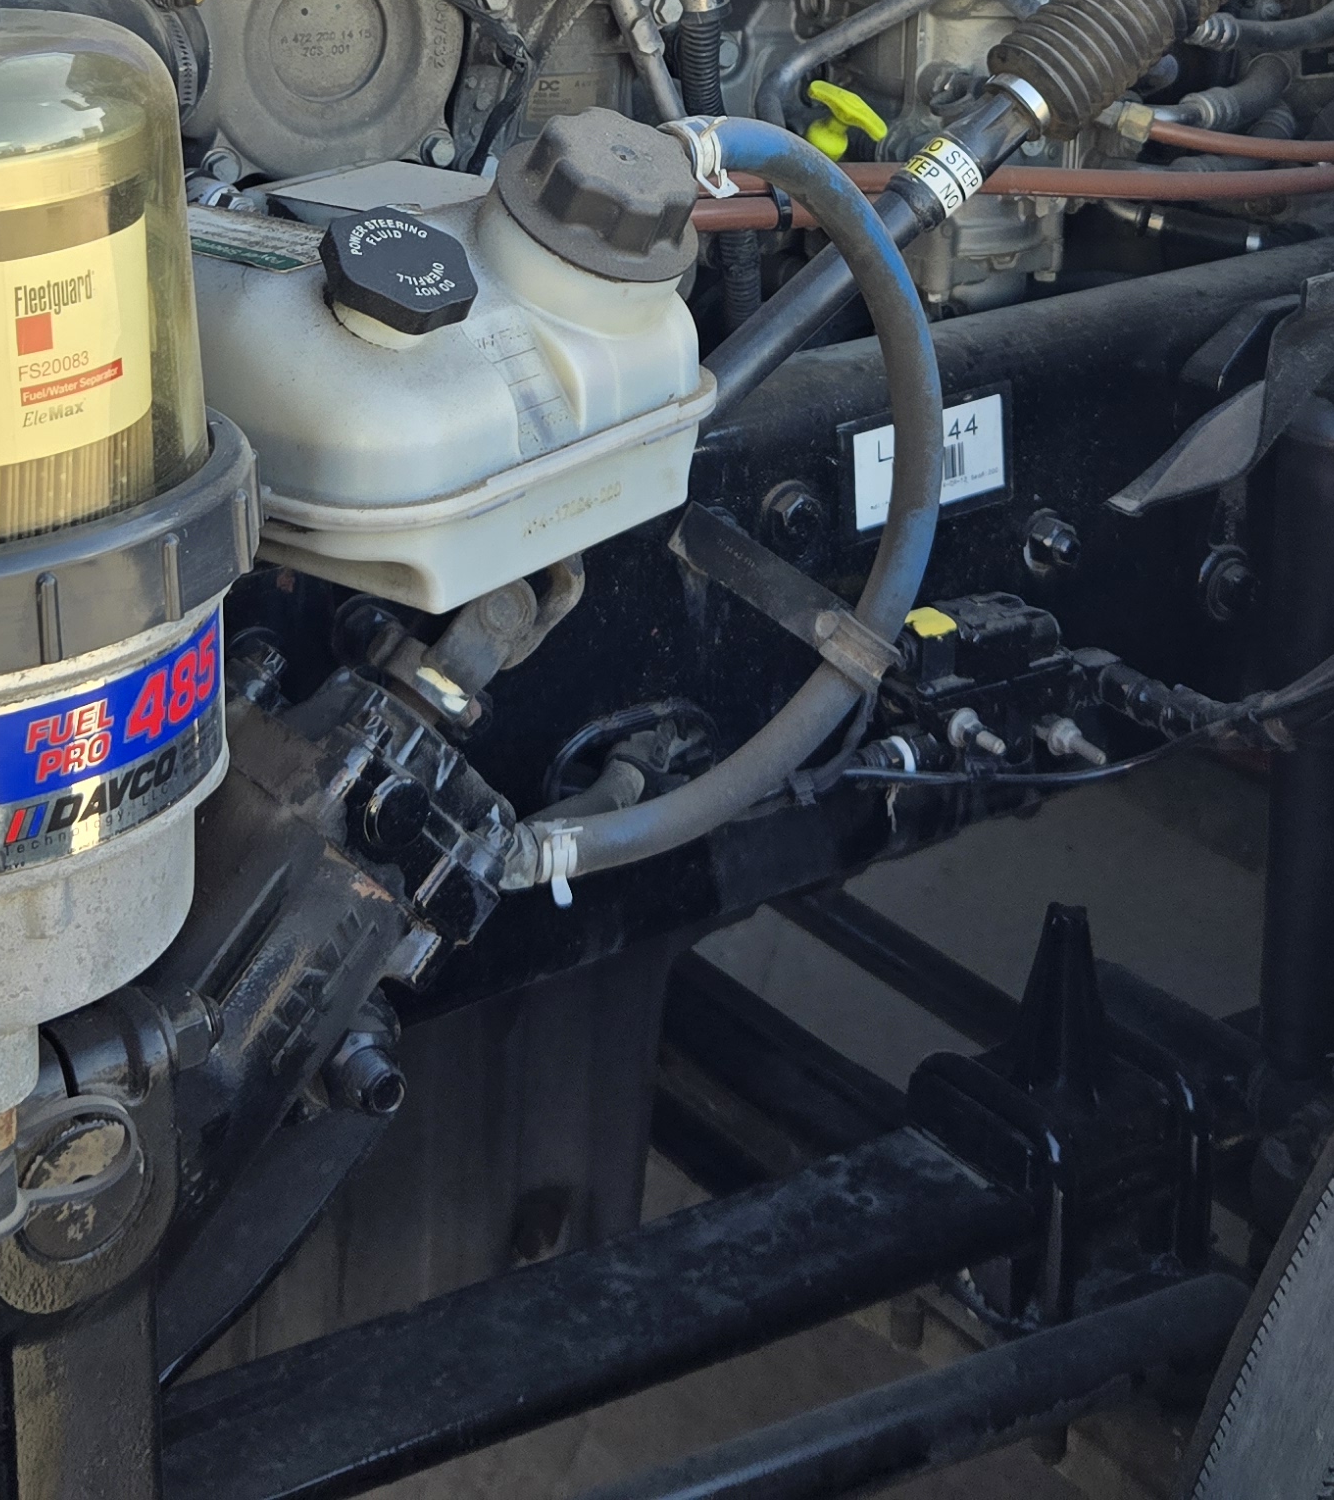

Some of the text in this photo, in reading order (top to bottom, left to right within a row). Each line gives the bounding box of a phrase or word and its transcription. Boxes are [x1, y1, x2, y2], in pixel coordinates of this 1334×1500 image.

[946, 150, 979, 188] STEP
[939, 183, 960, 209] NO
[348, 225, 369, 256] POWER
[364, 218, 428, 239] STEERING
[365, 229, 403, 246] FLUID
[396, 262, 445, 286] OVERFILL
[415, 279, 456, 296] DO NOT
[14, 269, 93, 317] Fleetguard
[18, 350, 90, 382] FS20083
[22, 366, 121, 403] Fuel/Water Separator
[22, 400, 85, 428] EleMax
[123, 619, 218, 745] 485
[25, 697, 115, 754] FUEL
[34, 729, 113, 785] PRO
[45, 745, 179, 835] DAVCO
[141, 780, 171, 808] LLC
